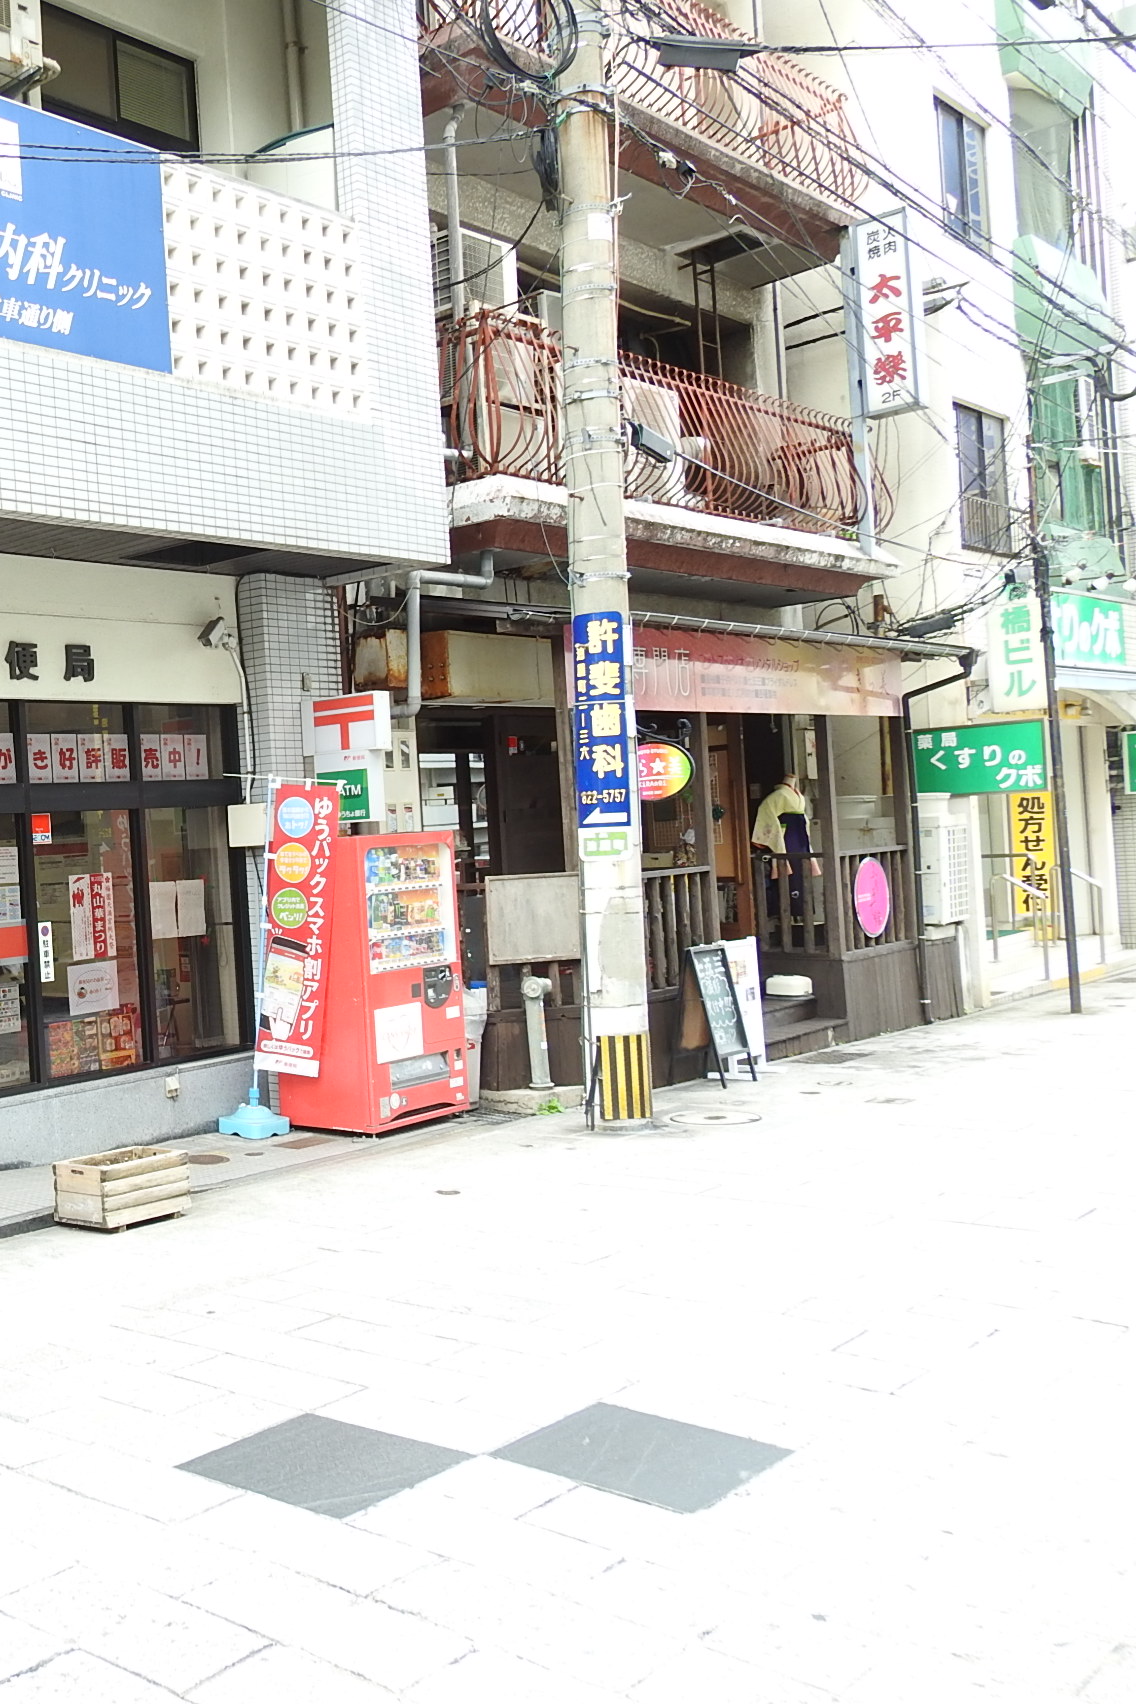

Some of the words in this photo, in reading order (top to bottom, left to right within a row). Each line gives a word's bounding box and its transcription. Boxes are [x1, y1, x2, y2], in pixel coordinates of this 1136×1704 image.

[882, 390, 901, 404] 2F
[586, 618, 625, 779] 許斐歯科
[917, 732, 958, 750] 薬局
[930, 745, 1026, 770] くすりの
[996, 764, 1043, 789] クボ
[340, 784, 362, 796] ATM
[299, 797, 332, 1041] ゆうパックスマホ割アプリ
[42, 939, 52, 980] 駐車禁止
